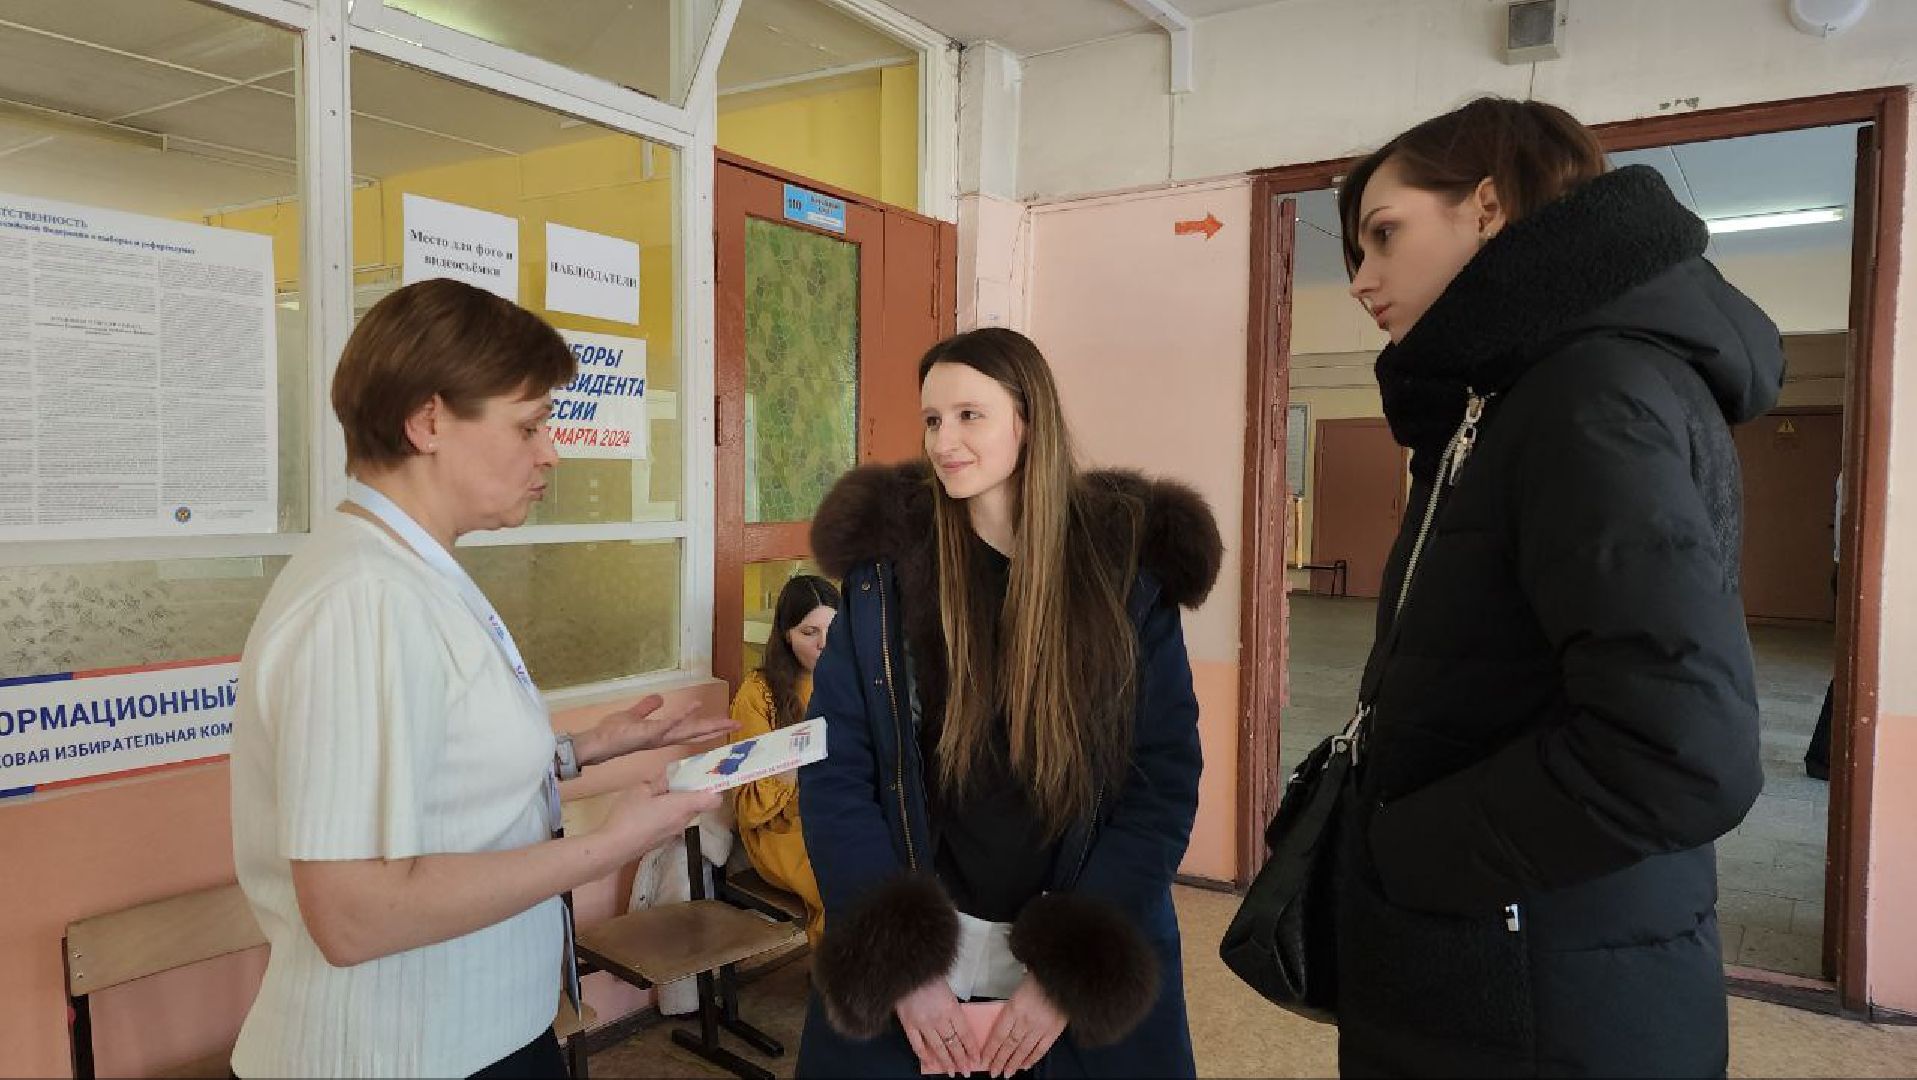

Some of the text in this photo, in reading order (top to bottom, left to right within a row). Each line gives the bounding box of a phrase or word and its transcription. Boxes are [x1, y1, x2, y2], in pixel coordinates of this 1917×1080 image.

[410, 229, 513, 260] Место для фото и
[424, 255, 501, 276] видеосъёмки
[550, 261, 637, 288] НАБЛЮДАТЕЛИ
[569, 343, 624, 368] БОРЫ
[552, 427, 598, 447] МАРТА
[599, 428, 631, 447] 2024
[0, 722, 233, 769] ОВАЯ ИЗБИРАТЕЛЬНАЯ КОМ
